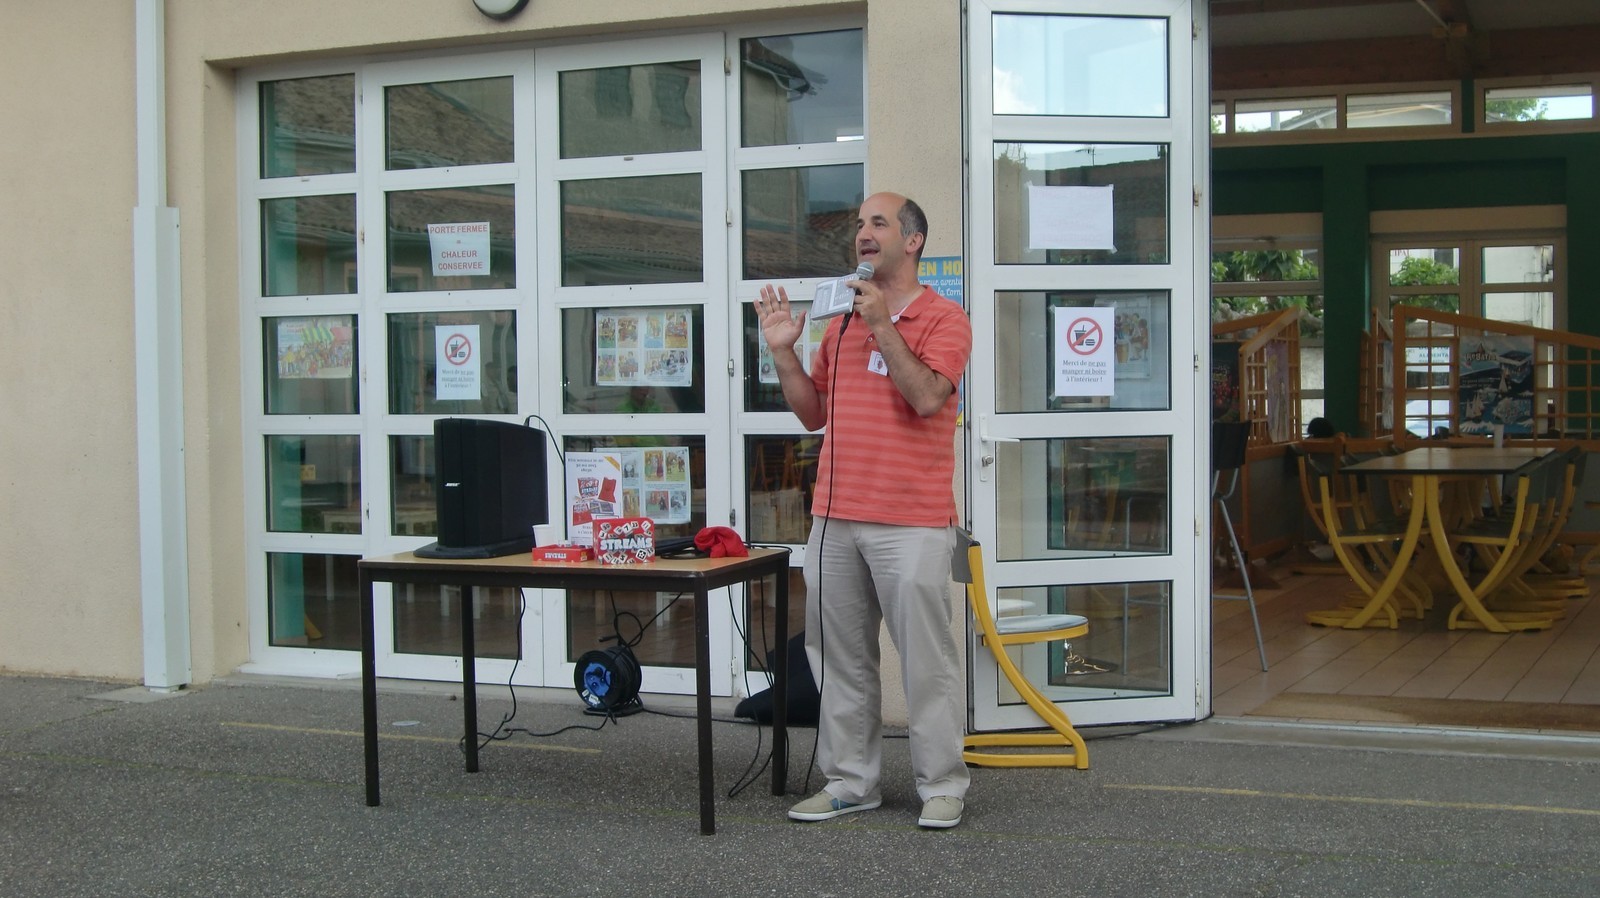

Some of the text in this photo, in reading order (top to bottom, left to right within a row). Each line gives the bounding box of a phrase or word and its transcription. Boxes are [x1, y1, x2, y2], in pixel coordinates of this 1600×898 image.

[430, 225, 487, 234] PORTE FERMEE
[441, 250, 477, 258] CHALEUR
[438, 261, 483, 270] CONSERVEE
[600, 537, 653, 550] STREAMS
